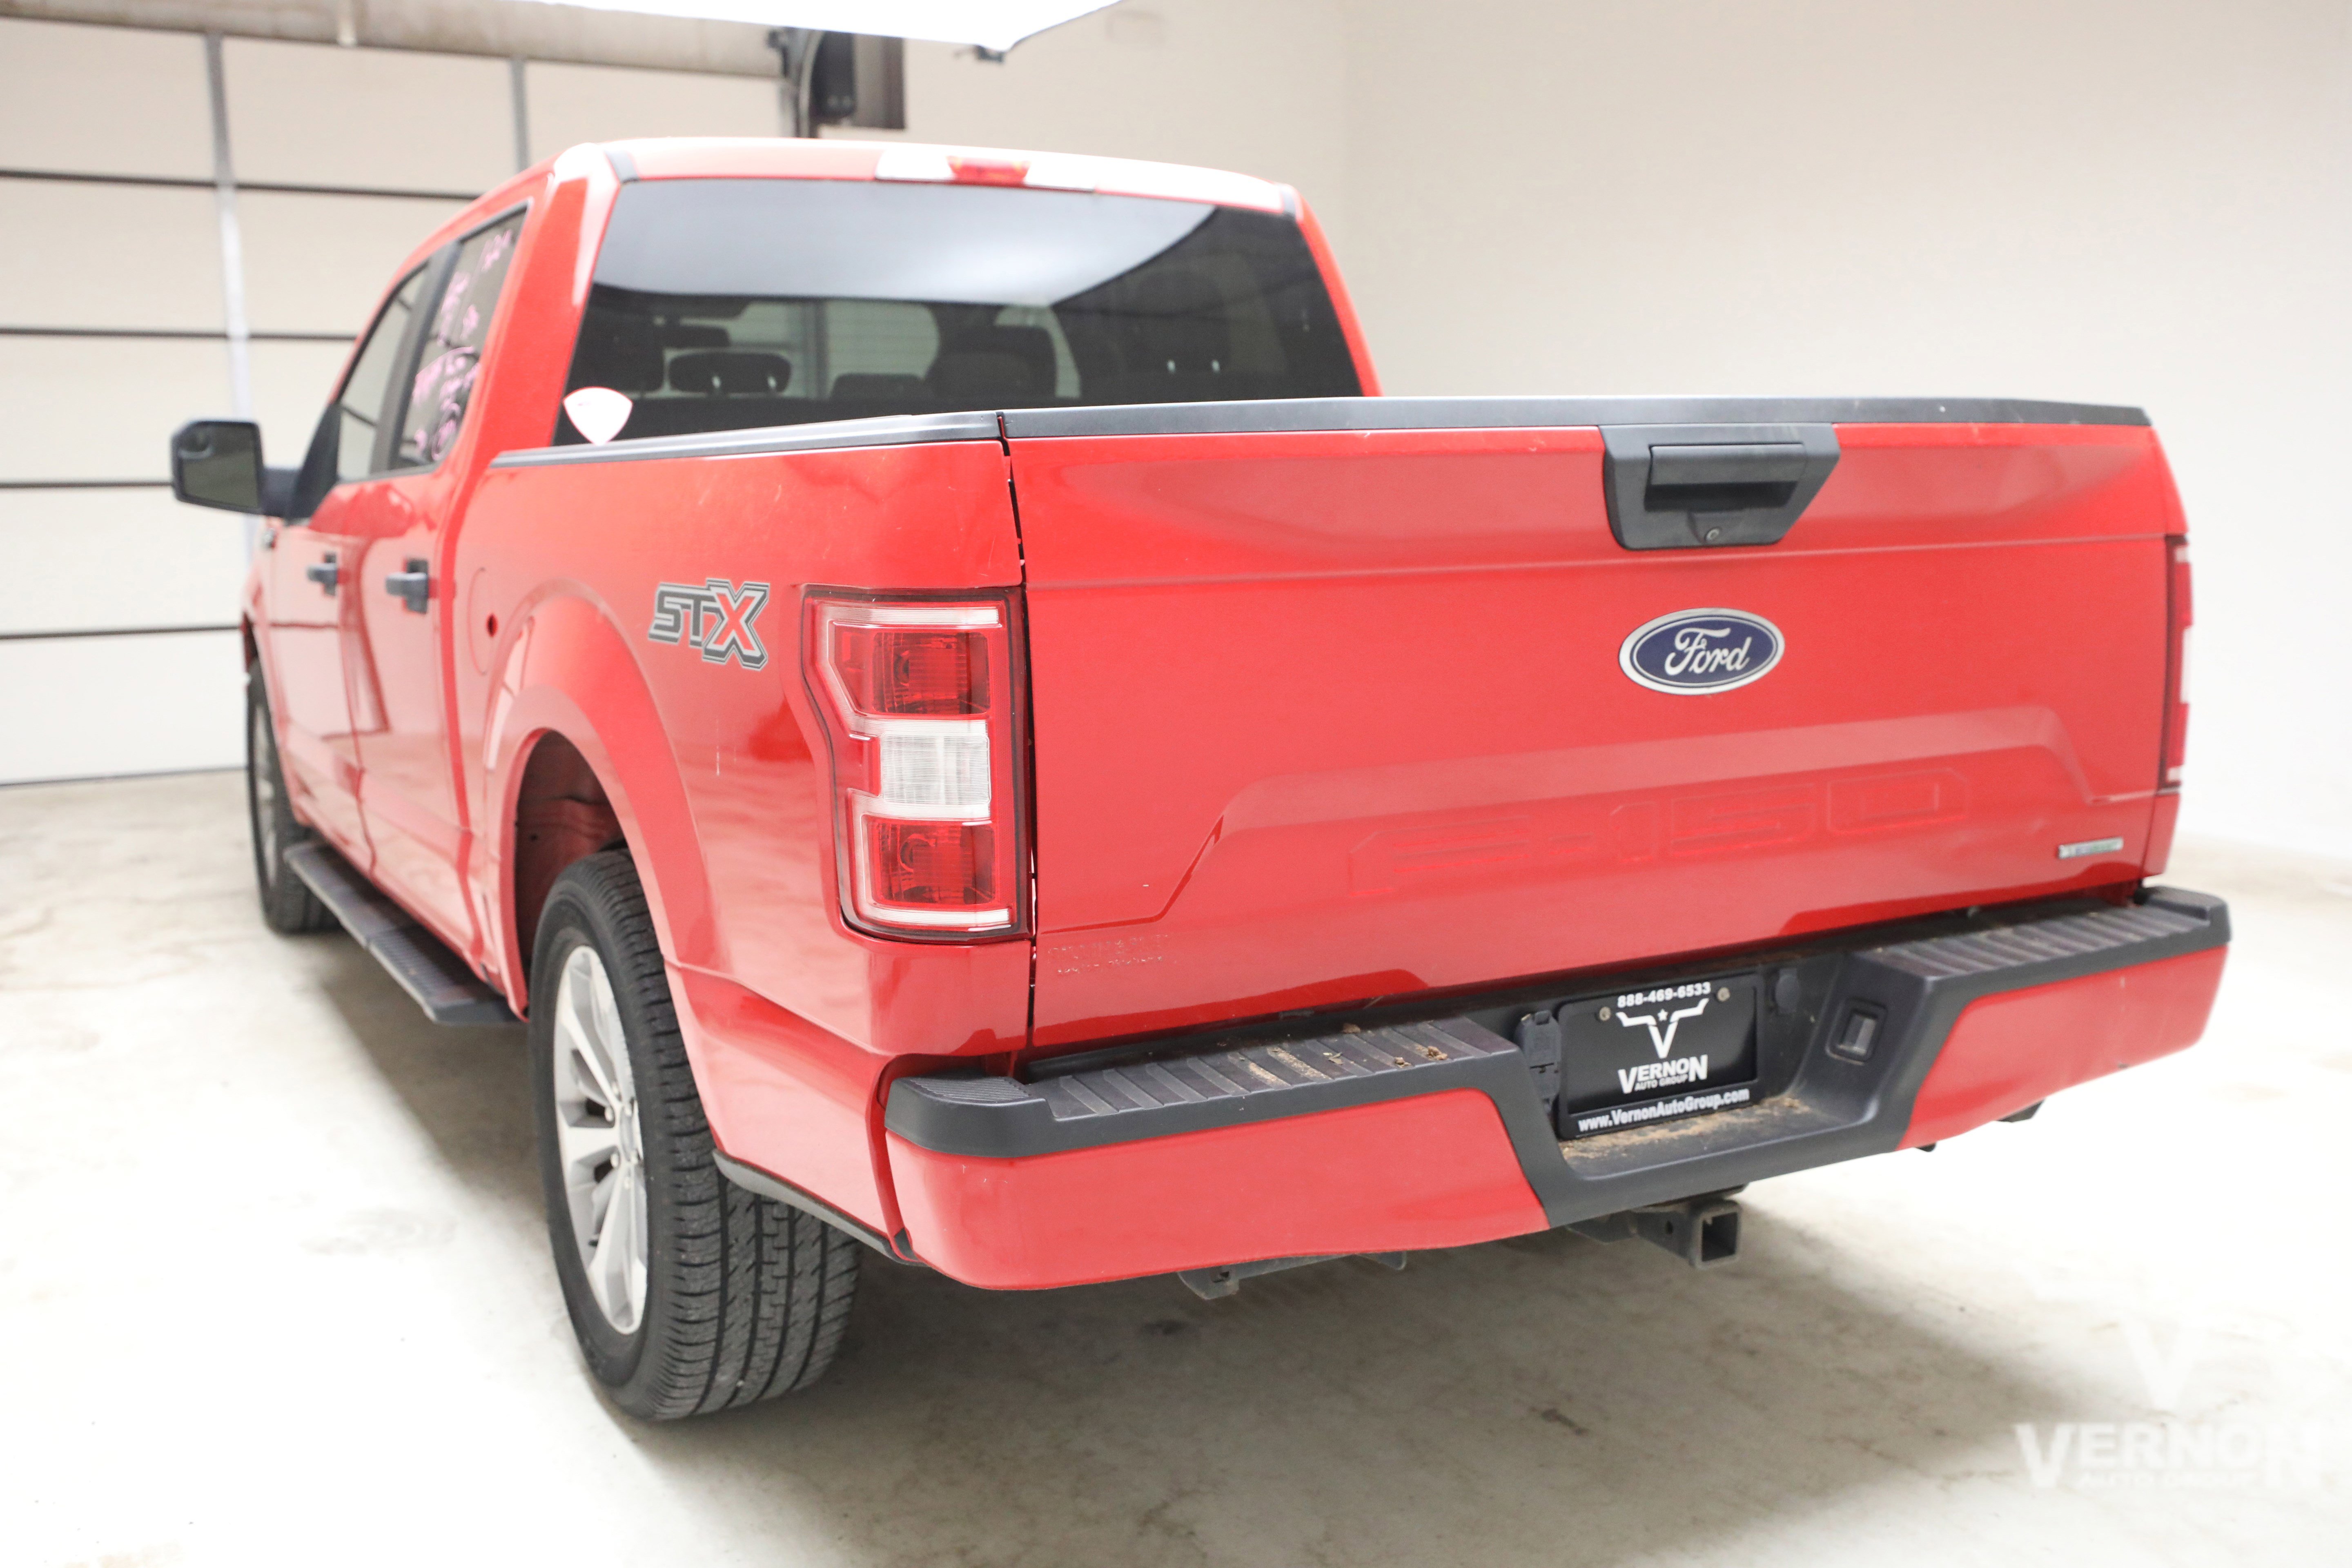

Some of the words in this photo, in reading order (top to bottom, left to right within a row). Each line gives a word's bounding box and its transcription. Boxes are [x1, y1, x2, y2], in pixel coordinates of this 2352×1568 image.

[648, 578, 770, 671] STX
[1665, 627, 1753, 676] Ford
[1347, 766, 1971, 897] F-150
[1617, 981, 1711, 1008] 888-469-6533
[1617, 1054, 1708, 1094] VERNON
[1634, 1079, 1658, 1091] AUTO
[1659, 1074, 1688, 1087] GROUP
[1578, 1088, 1750, 1132] www.VernonAutoGroup.com
